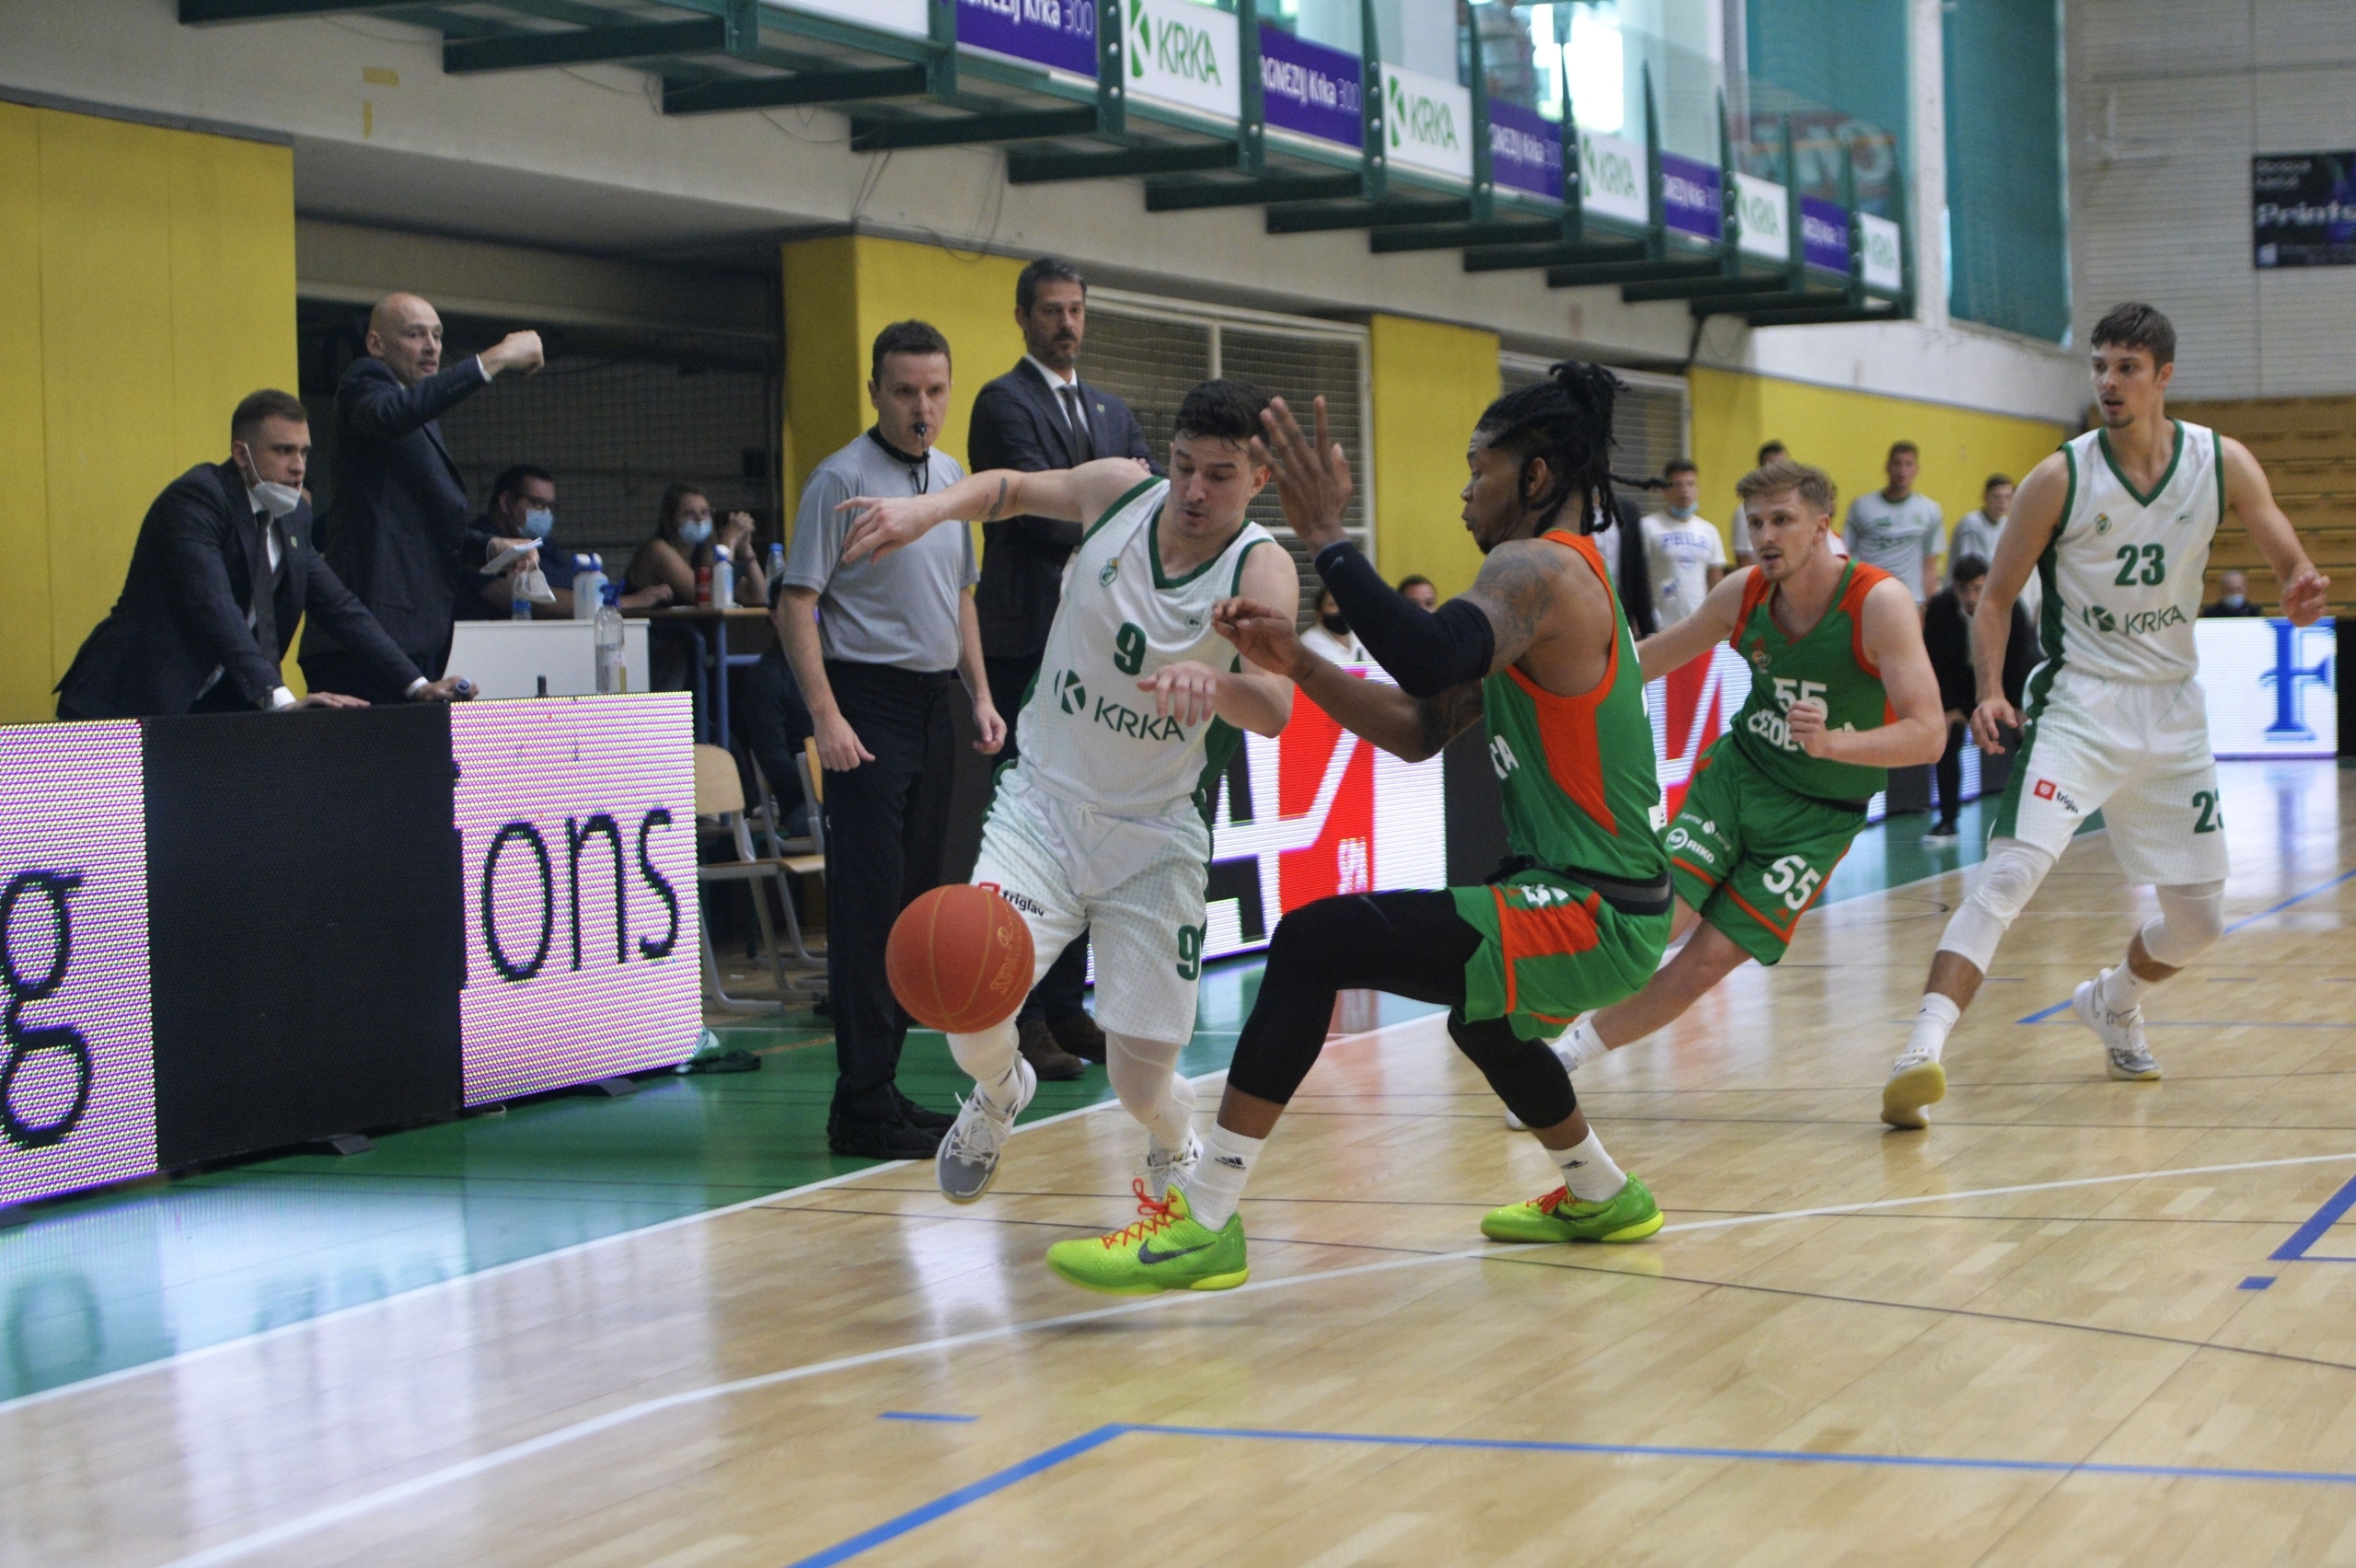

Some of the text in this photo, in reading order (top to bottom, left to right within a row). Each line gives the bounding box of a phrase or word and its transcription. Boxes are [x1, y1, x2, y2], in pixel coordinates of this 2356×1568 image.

[1158, 16, 1222, 86] KRKA
[1410, 93, 1460, 152] KRKA
[2115, 542, 2166, 586] 23
[2125, 605, 2188, 636] KRKA
[1114, 621, 1147, 676] 9
[1093, 695, 1186, 743] KRKA
[1773, 676, 1830, 727] 55
[1686, 838, 1715, 864] RIKO
[480, 808, 680, 982] ons
[1002, 890, 1045, 917] triglav
[1761, 854, 1822, 911] 55
[1175, 924, 1203, 982] 9
